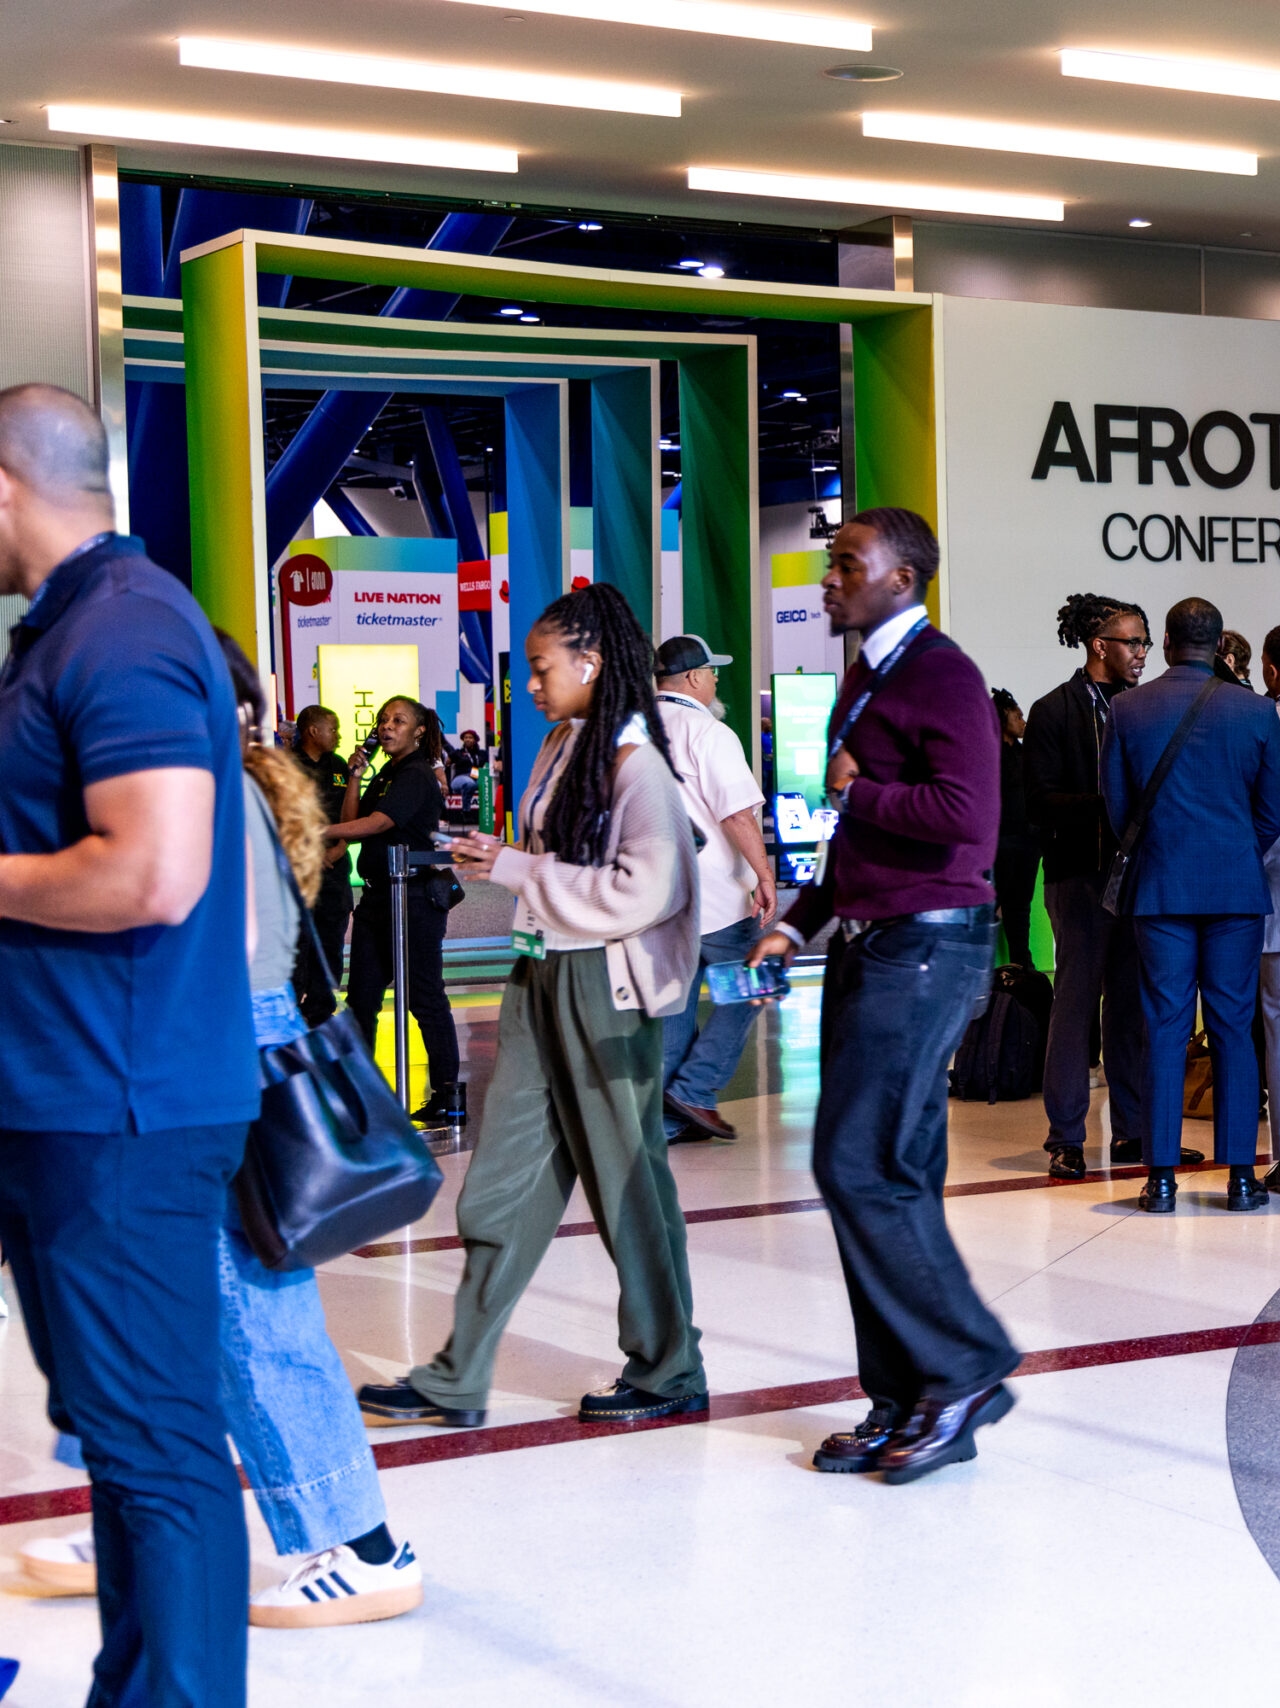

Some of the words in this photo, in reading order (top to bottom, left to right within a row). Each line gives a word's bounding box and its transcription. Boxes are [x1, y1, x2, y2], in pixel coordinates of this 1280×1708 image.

[354, 592, 384, 603] LIVE
[387, 593, 441, 604] NATION
[356, 613, 438, 626] ticketmaster
[776, 610, 806, 623] GEICO
